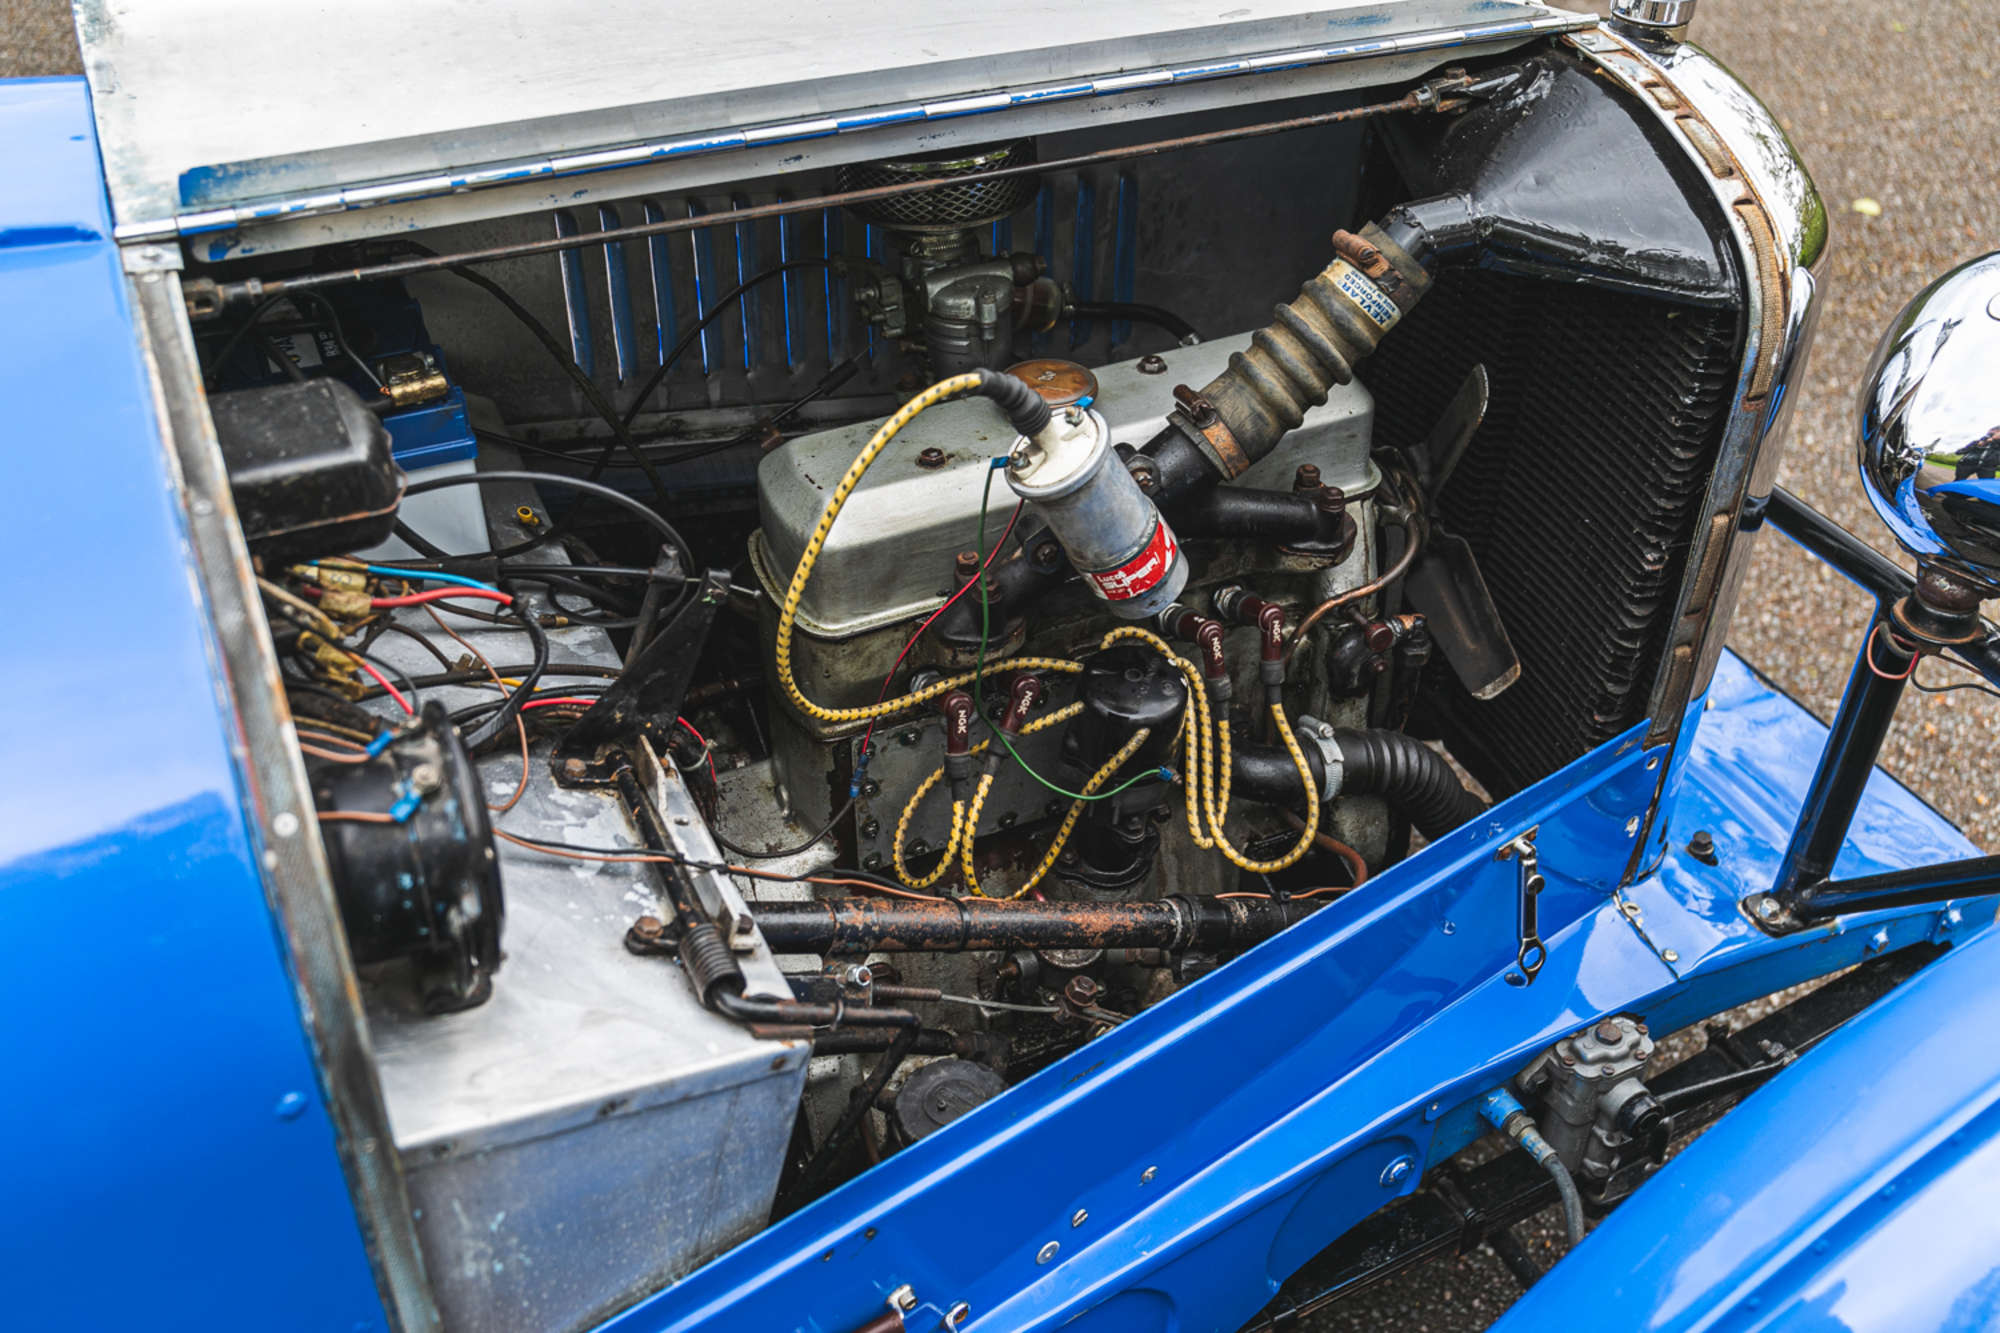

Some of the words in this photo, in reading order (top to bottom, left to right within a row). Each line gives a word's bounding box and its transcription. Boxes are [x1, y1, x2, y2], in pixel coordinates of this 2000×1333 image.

[1344, 273, 1392, 319] REINFORCED
[1271, 619, 1281, 643] NGK
[1211, 636, 1223, 660] NGK
[1017, 690, 1033, 715] NGK
[957, 709, 967, 734] NGK
